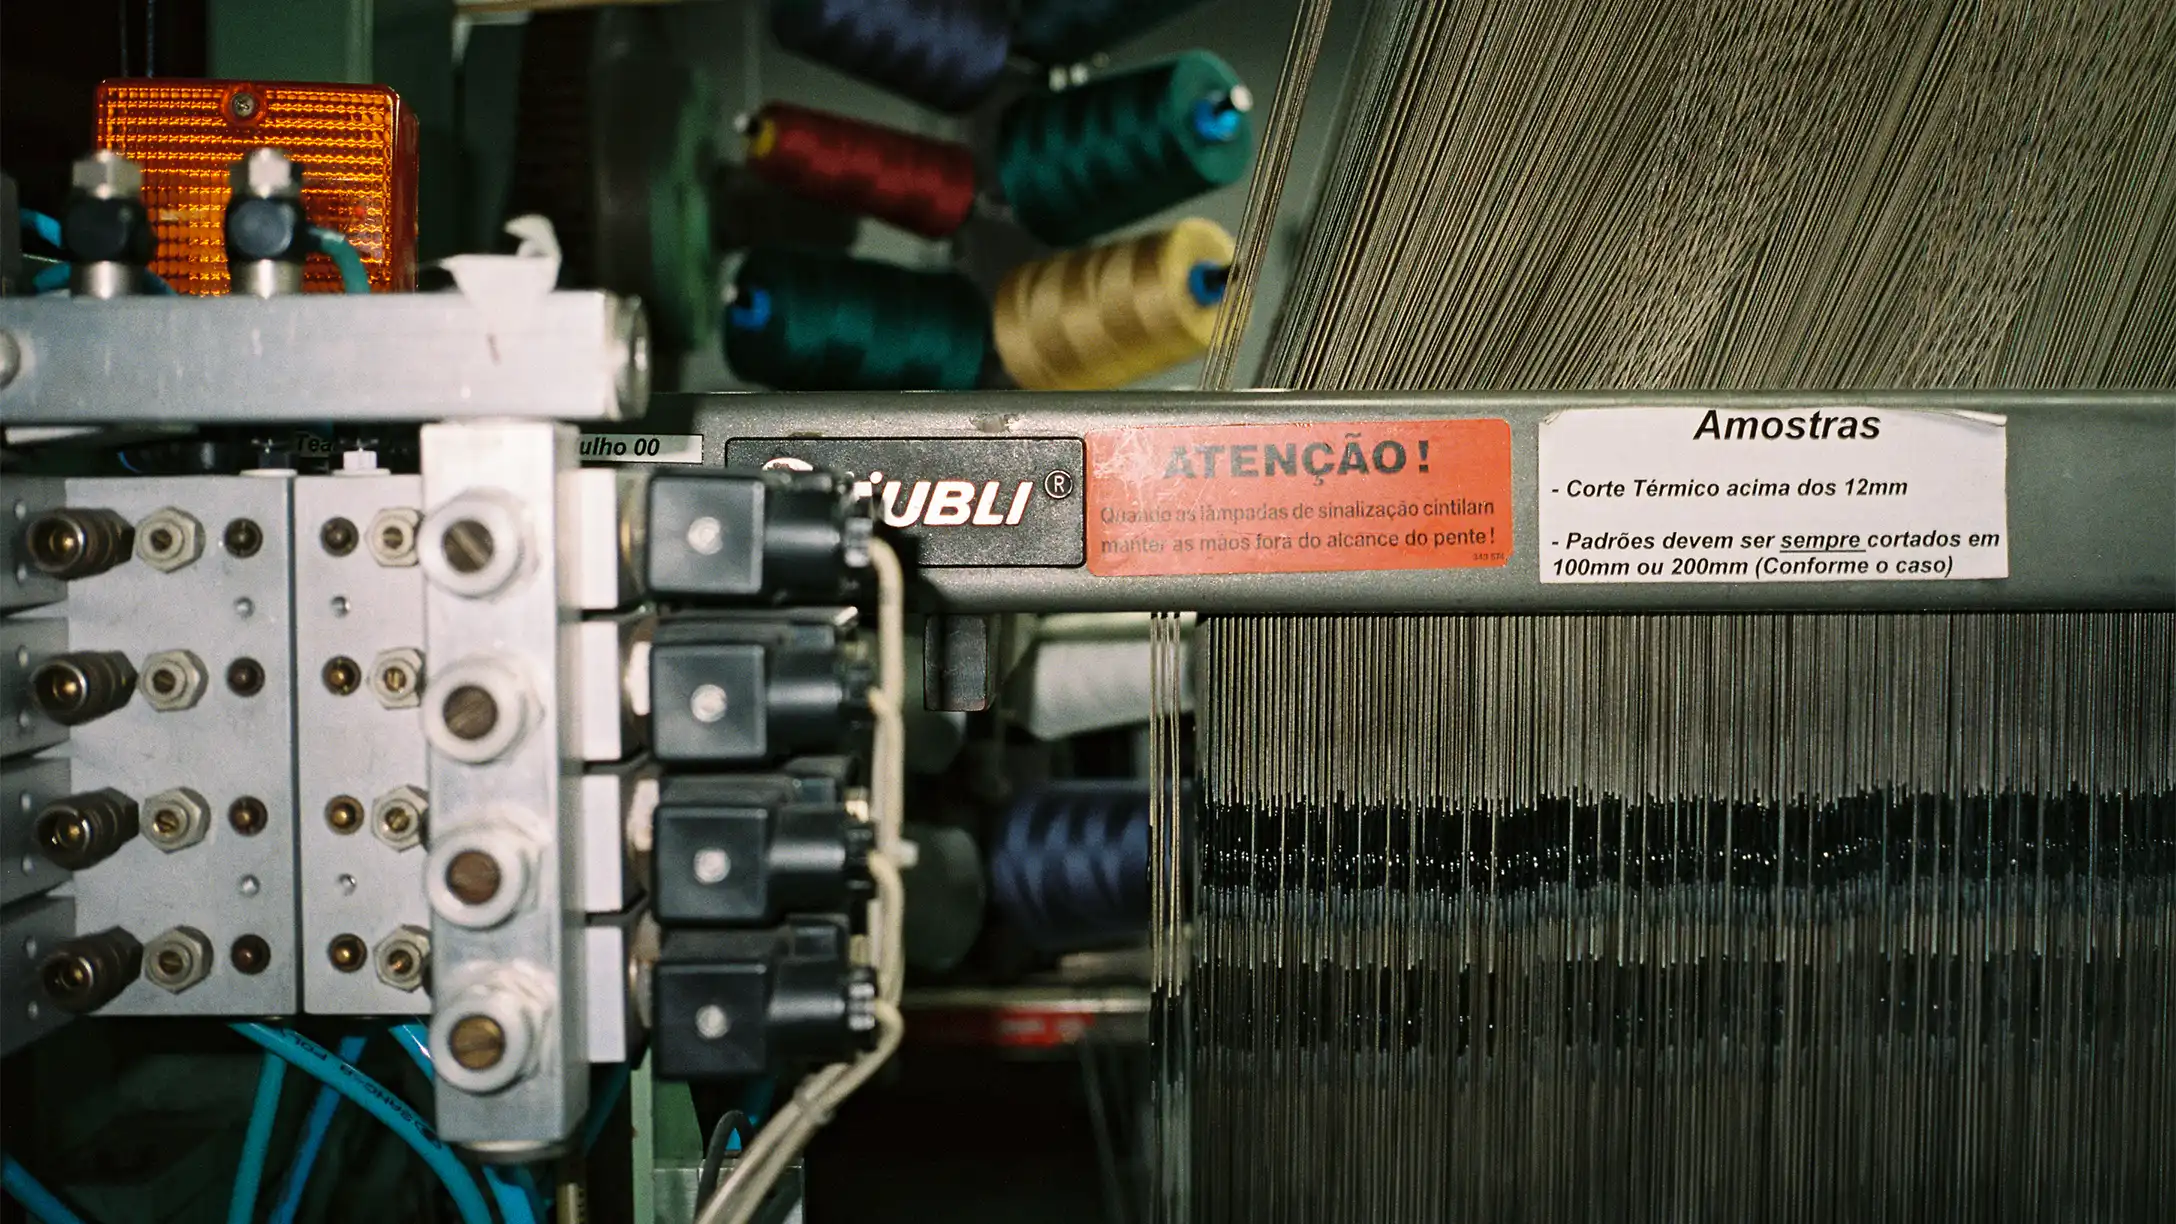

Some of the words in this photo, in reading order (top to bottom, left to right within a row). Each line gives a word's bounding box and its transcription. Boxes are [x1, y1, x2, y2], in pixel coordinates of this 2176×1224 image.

[1692, 409, 1882, 440] Amostras
[579, 437, 627, 456] ulho
[633, 438, 660, 456] 00
[1566, 479, 1625, 498] Corte
[1633, 478, 1720, 497] Térmico
[1726, 478, 1790, 497] acima
[1797, 478, 1837, 497] dos
[1845, 478, 1908, 496] 12mm
[1200, 503, 1289, 525] lâmpadas
[1292, 503, 1315, 519] de
[1319, 500, 1419, 521] sinalização
[1172, 539, 1195, 552] as
[1256, 532, 1293, 550] fora
[1298, 531, 1322, 549] do
[1327, 531, 1400, 548] alcance
[1405, 529, 1428, 546] do
[1566, 532, 1655, 550] Padrões
[1662, 531, 1734, 549] devem
[1740, 534, 1776, 549] ser
[1779, 534, 1866, 552] sempre
[1867, 530, 1961, 548] cortados
[1968, 533, 2000, 548] em
[1553, 558, 1630, 576] 100mm
[1637, 562, 1664, 576] ou
[1671, 557, 1749, 576] 200mm
[1755, 556, 1869, 579] (Conforme
[1875, 560, 1889, 574] o
[1895, 555, 1953, 578] caso)
